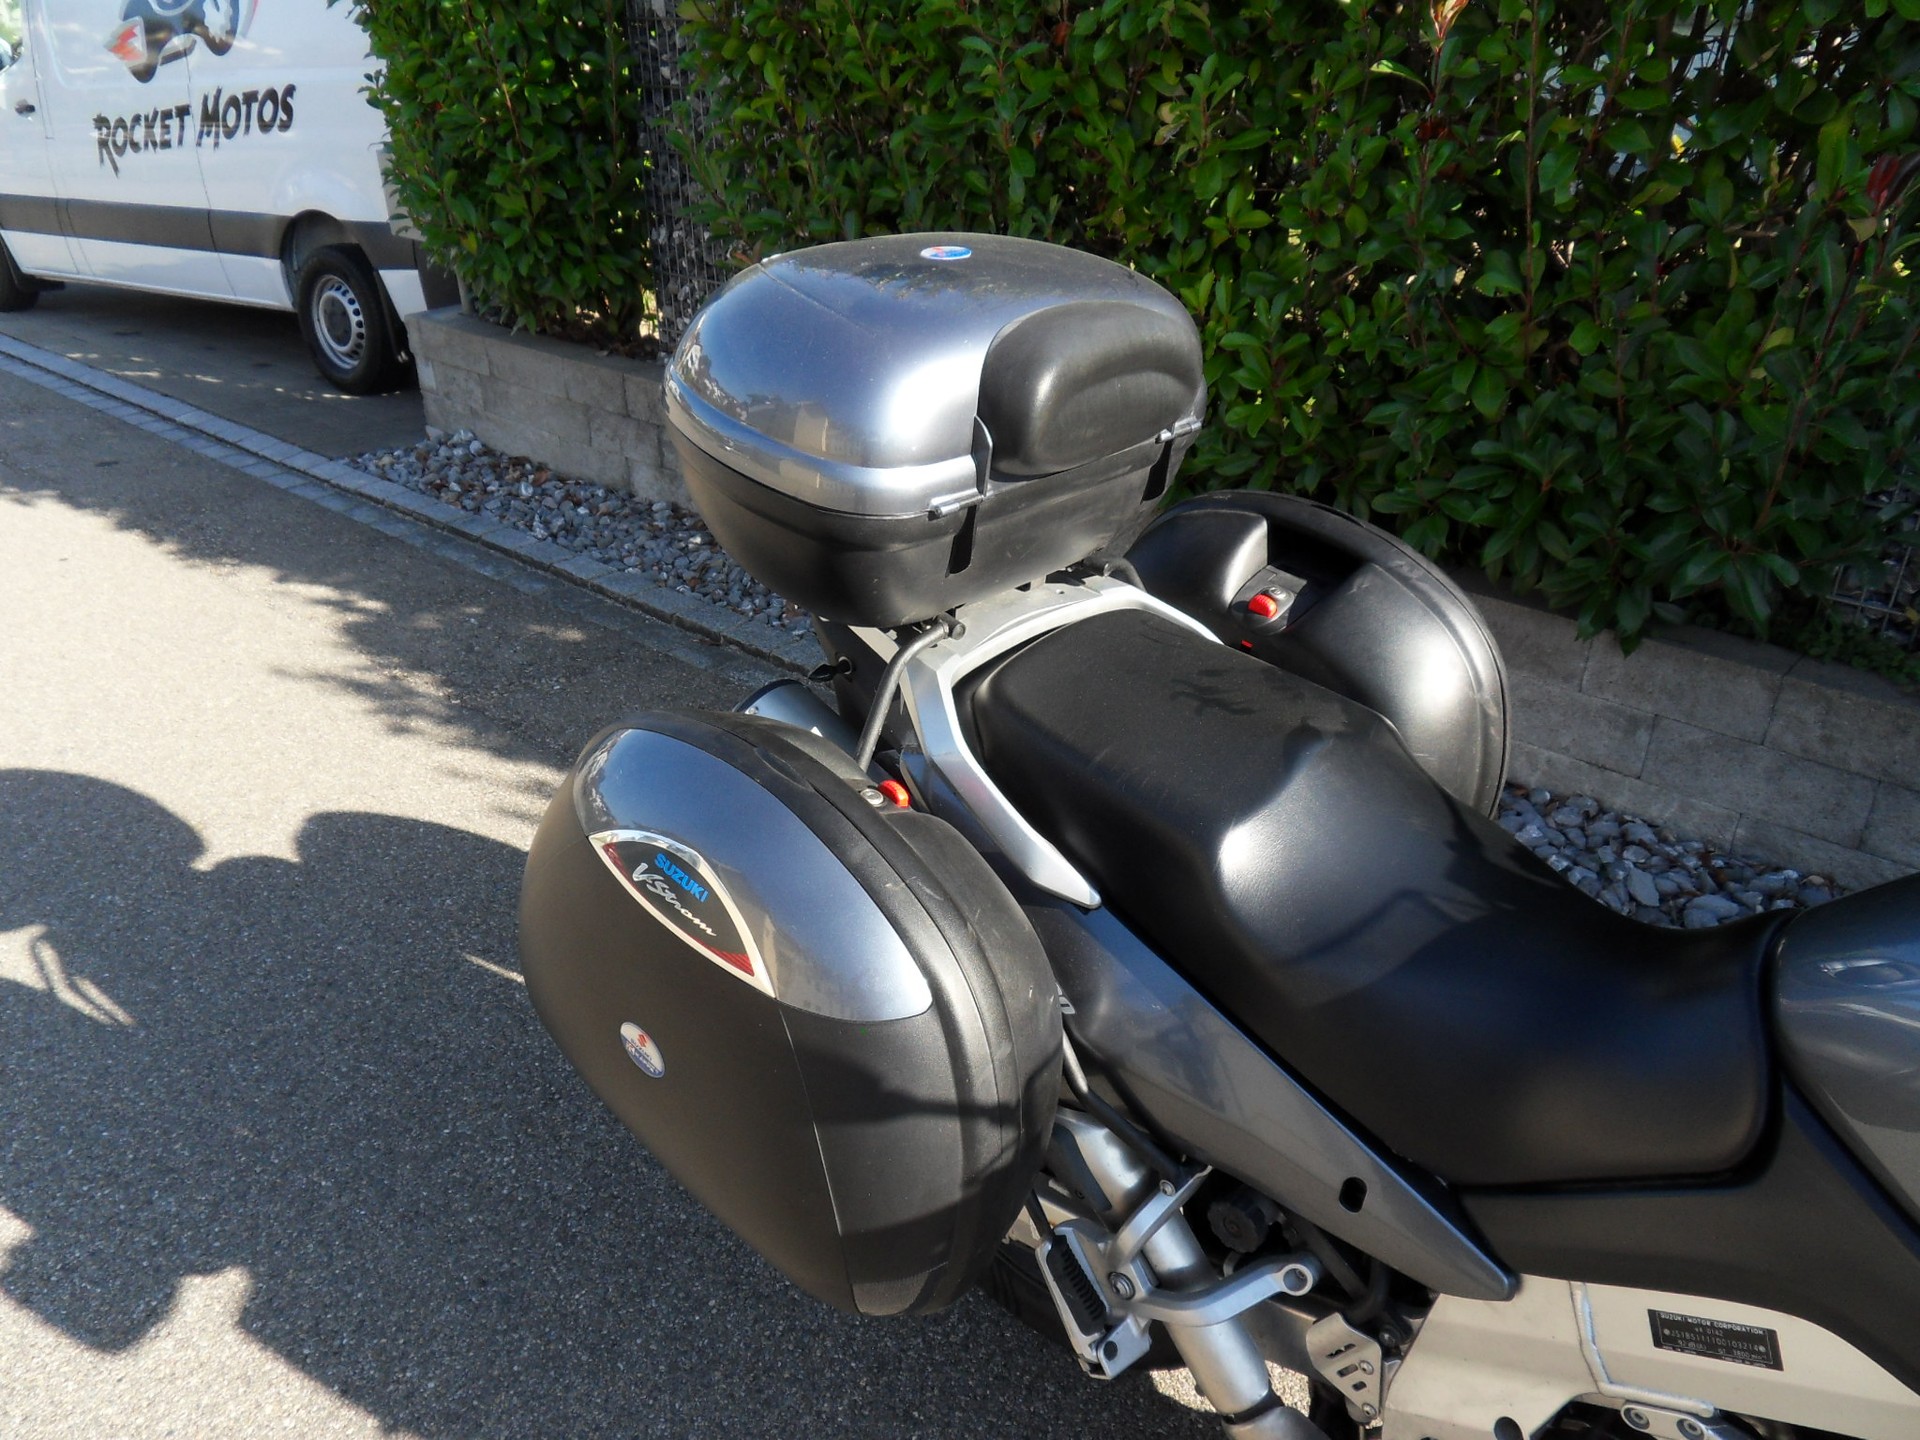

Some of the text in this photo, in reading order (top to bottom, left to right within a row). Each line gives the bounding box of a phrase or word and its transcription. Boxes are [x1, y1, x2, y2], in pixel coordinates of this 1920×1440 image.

[92, 84, 297, 179] ROCKET MOTOS
[654, 852, 709, 903] SUZUKI
[1660, 1311, 1764, 1335] SUZUKI MOTOR CORPORATION
